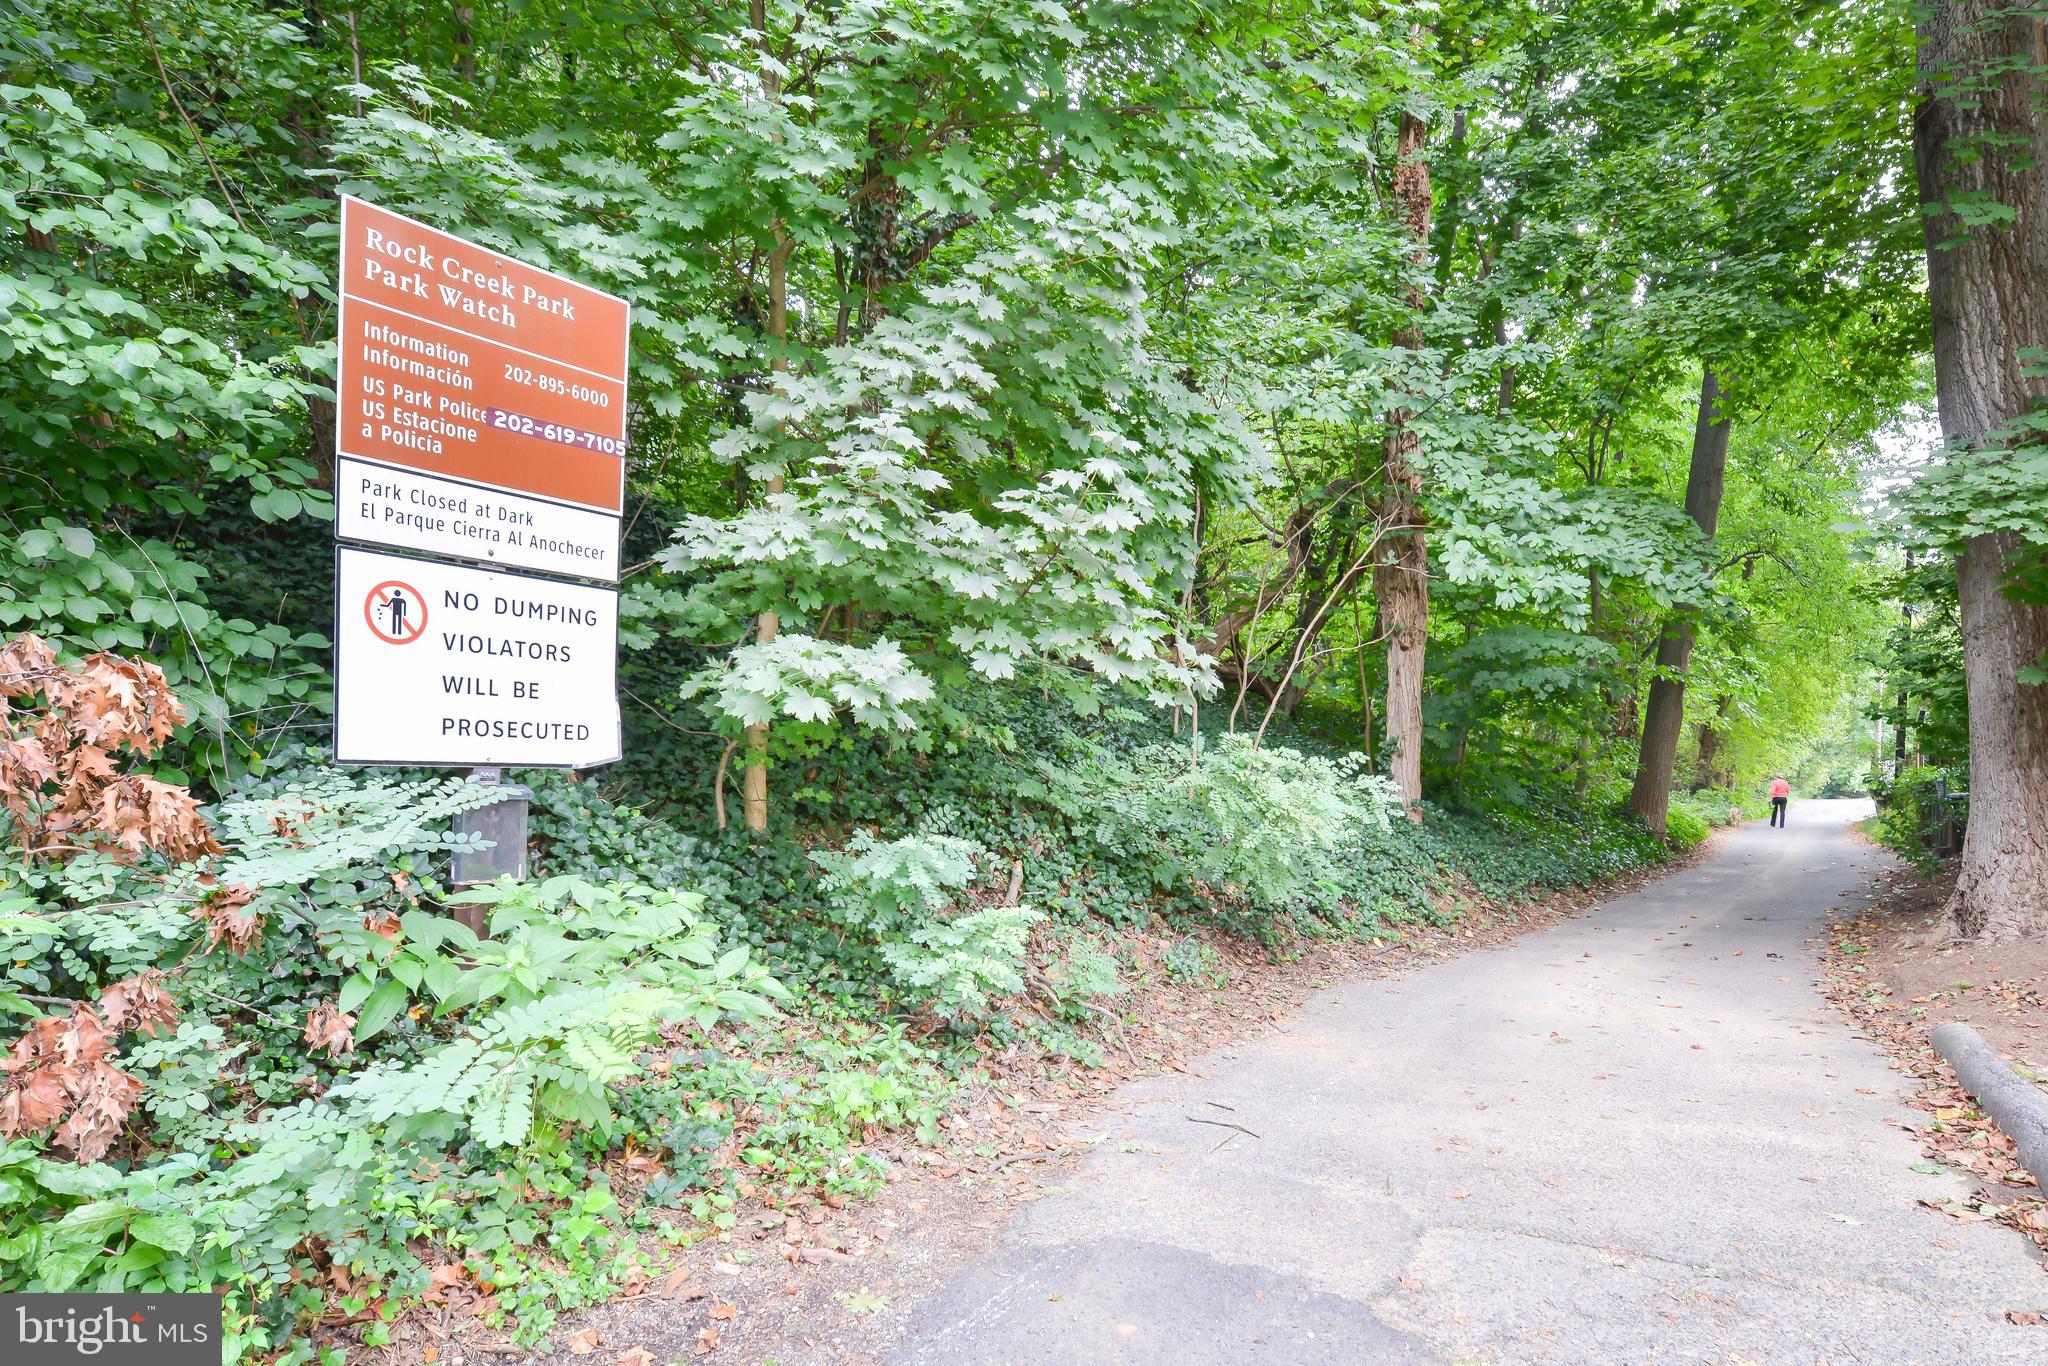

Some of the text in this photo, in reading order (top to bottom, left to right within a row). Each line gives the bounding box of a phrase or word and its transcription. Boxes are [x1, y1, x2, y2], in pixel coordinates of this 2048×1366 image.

[364, 258, 517, 328] Park Watch
[366, 227, 576, 320] Rock Creek Park
[363, 320, 470, 367] Information
[363, 344, 473, 390] Información
[504, 364, 609, 408] 202-895-6000
[362, 399, 477, 443] US Estacione
[363, 375, 487, 424] US Park Police
[361, 423, 442, 455] a Policía
[494, 410, 626, 456] 202-619-7105
[361, 479, 534, 527] Park Closed at Dark
[361, 503, 605, 561] El Parque Cierra Al Anochecer
[444, 590, 598, 627] NO DUMPING
[443, 633, 571, 662] VIOLATORS
[442, 676, 540, 700] WILL BE
[442, 718, 590, 741] PROSECUTED
